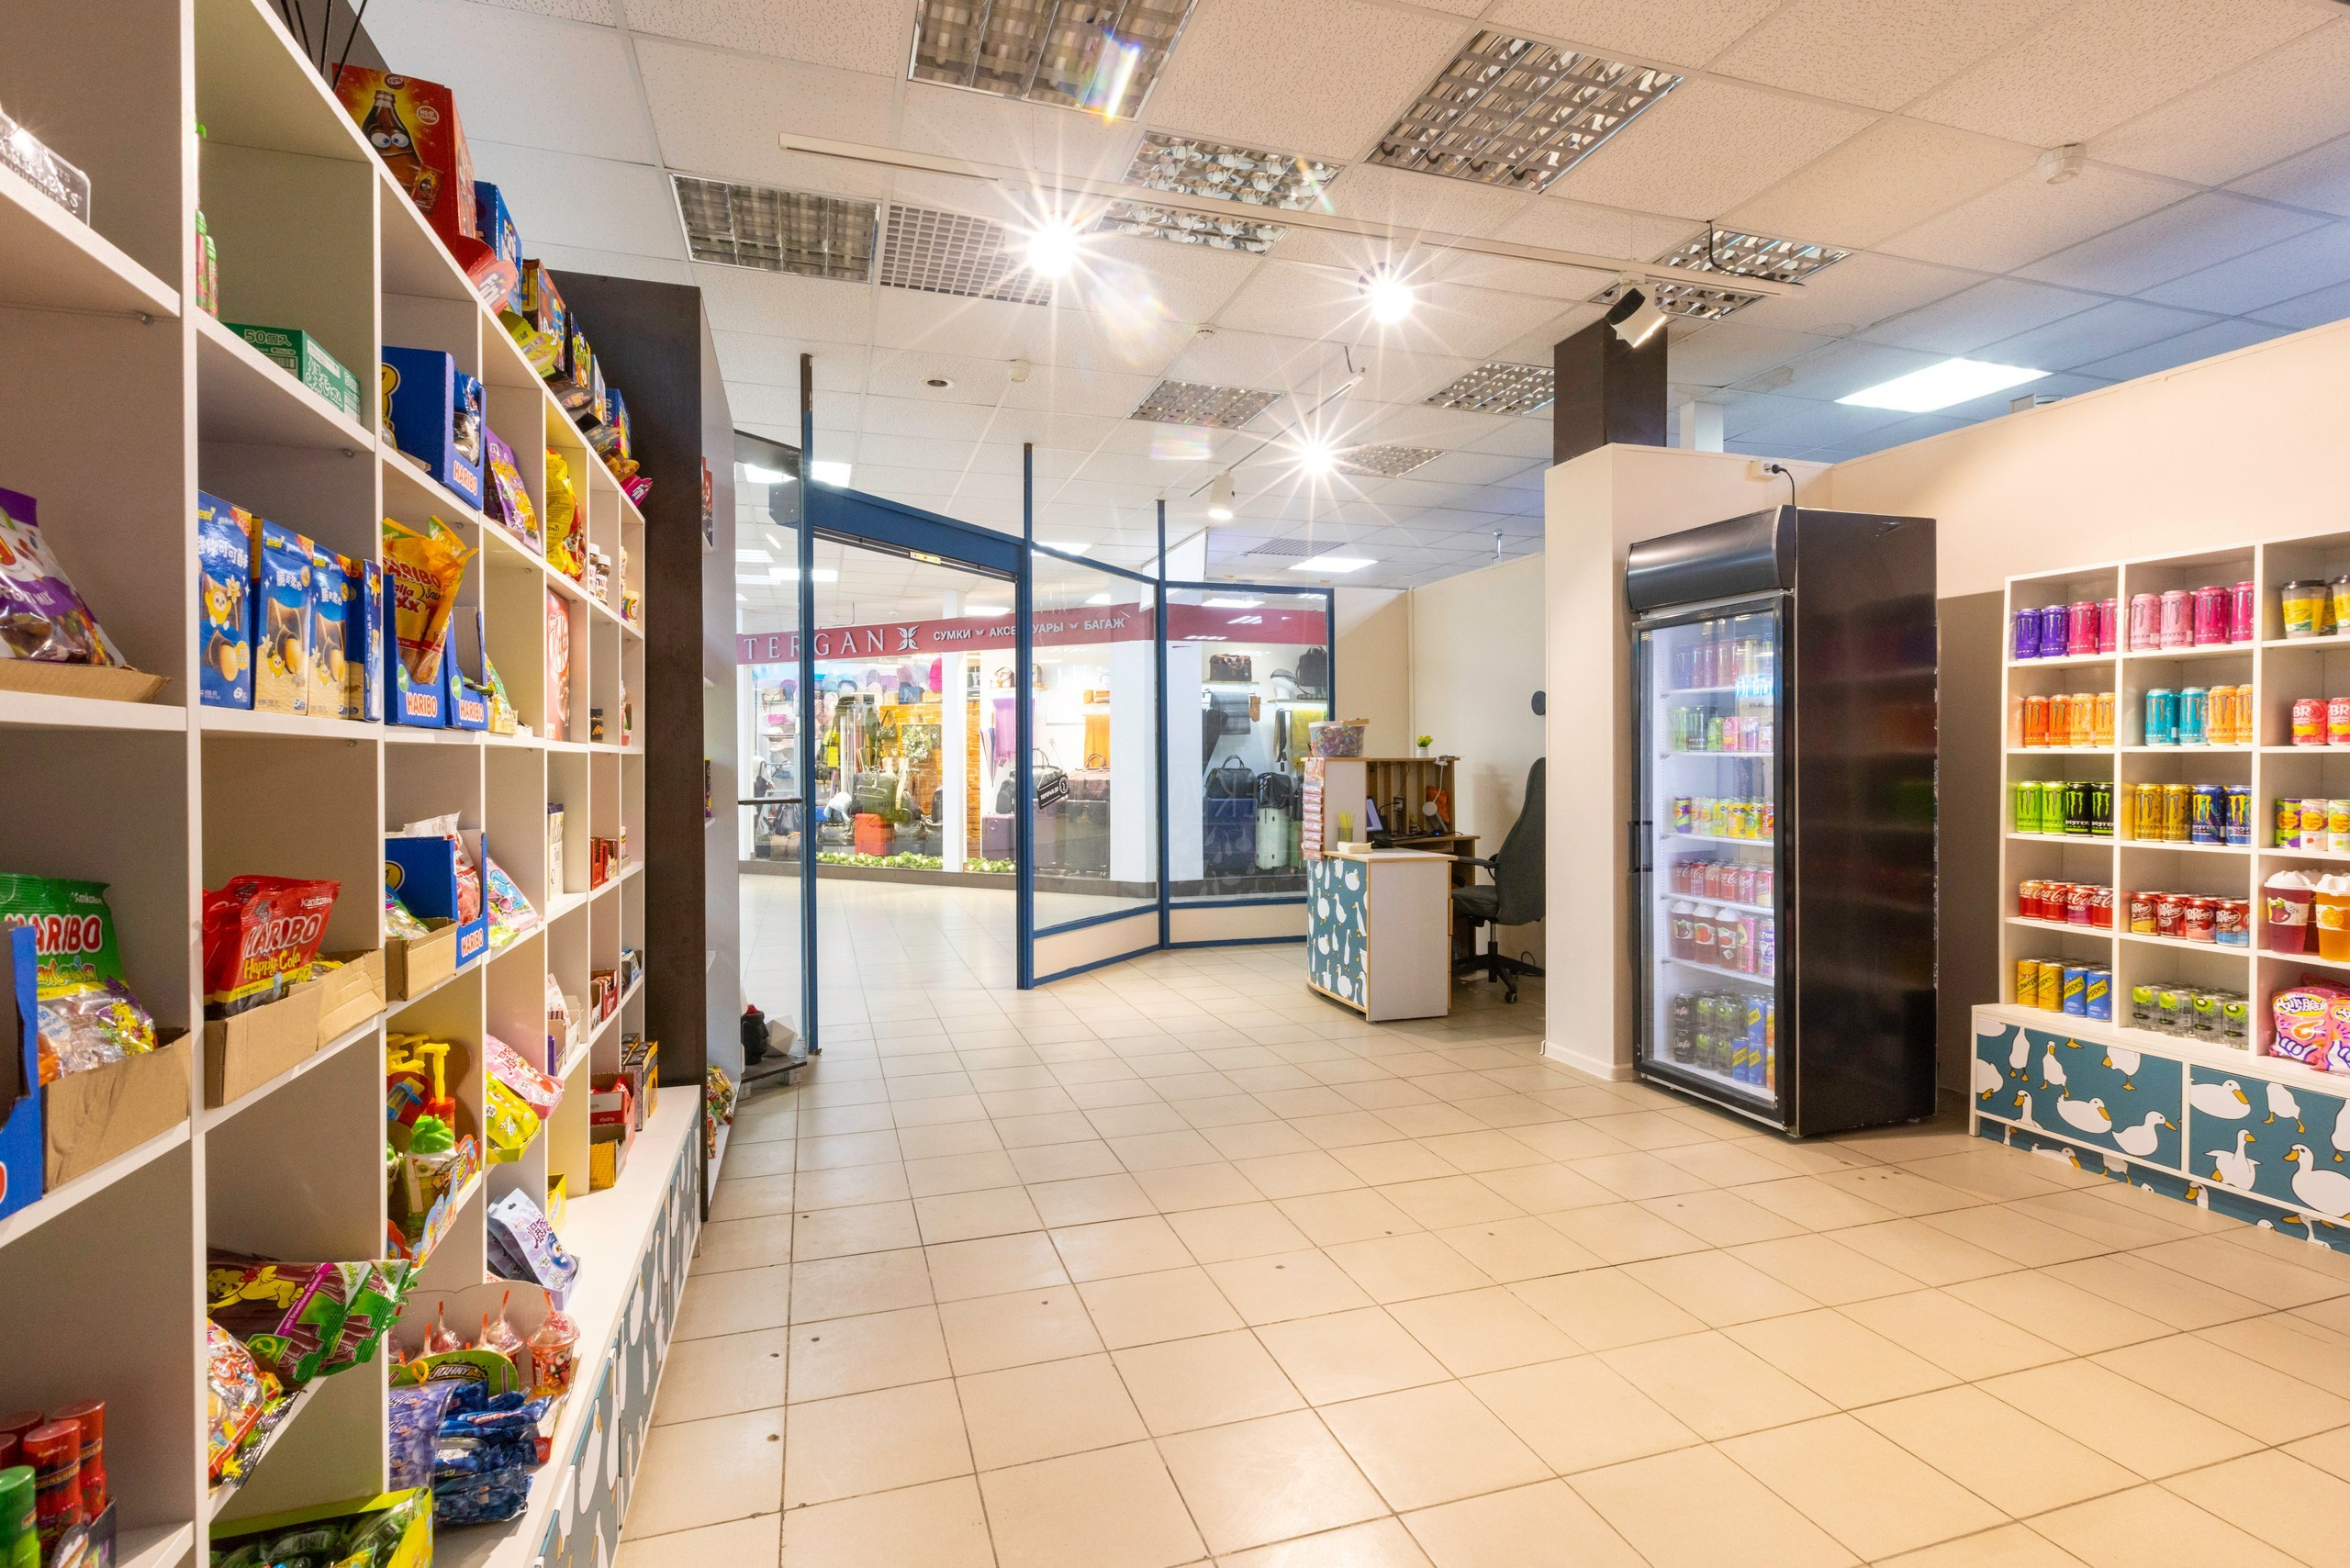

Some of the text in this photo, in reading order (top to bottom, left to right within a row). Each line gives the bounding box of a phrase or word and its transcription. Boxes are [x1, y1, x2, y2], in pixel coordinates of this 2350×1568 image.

[453, 460, 478, 497] HARIBO
[383, 557, 442, 591] ARIBO
[33, 591, 56, 606] MIX
[395, 584, 415, 597] alla
[934, 618, 1125, 641] СУМКИ АКСЕУАРЫ БАГАЖ
[406, 691, 439, 718] HARIBO
[459, 700, 485, 723] HARIBO
[5, 913, 103, 956] ARIBO
[243, 913, 322, 960] HARIBO
[461, 927, 484, 958] HARIBO
[37, 956, 98, 986] antasia
[2065, 981, 2084, 994] eppes
